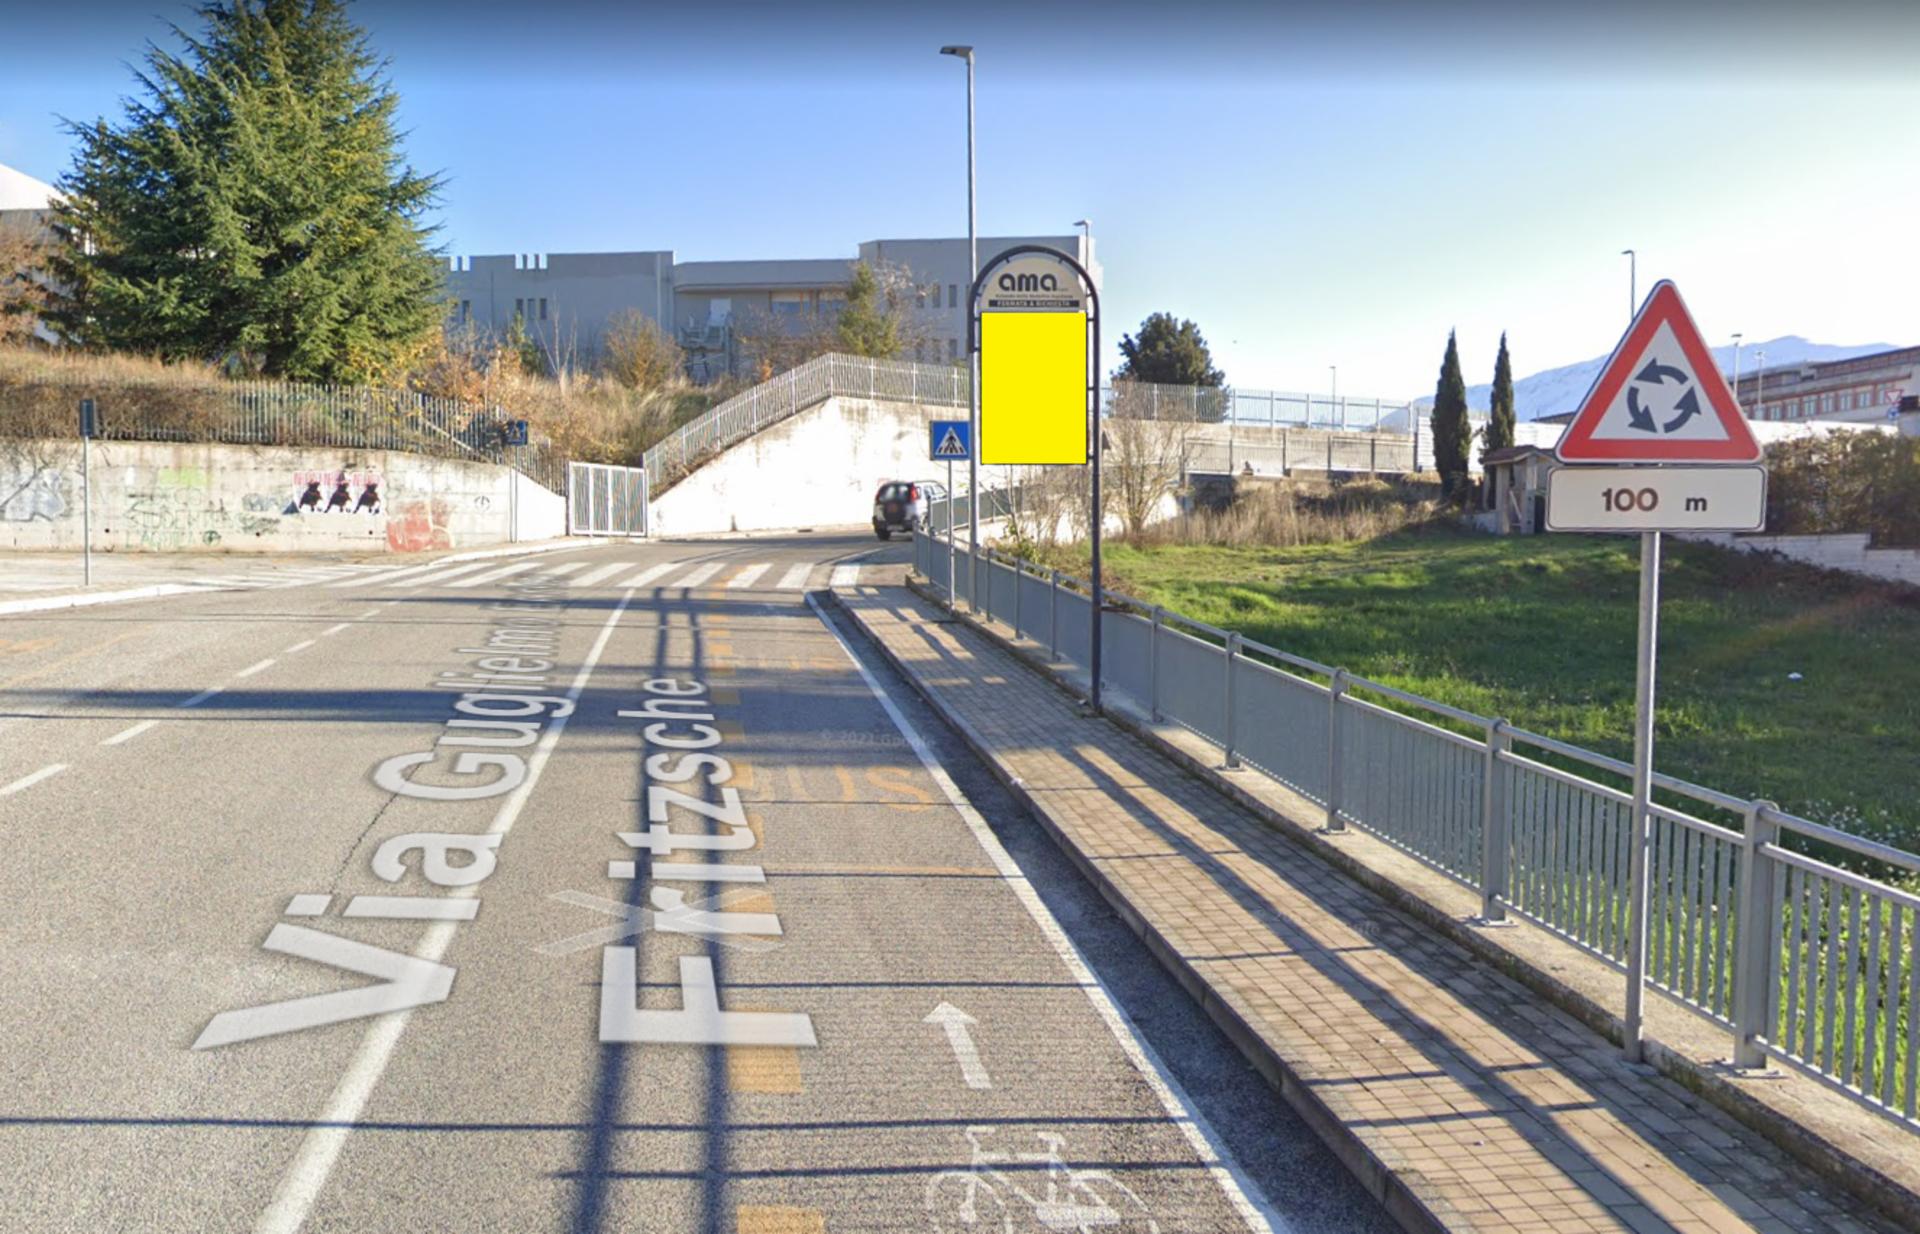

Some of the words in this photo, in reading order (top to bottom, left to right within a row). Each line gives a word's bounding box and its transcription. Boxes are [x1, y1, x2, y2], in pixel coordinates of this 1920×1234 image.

[998, 272, 1058, 291] ama
[1602, 487, 1659, 512] 100
[1685, 496, 1708, 512] m
